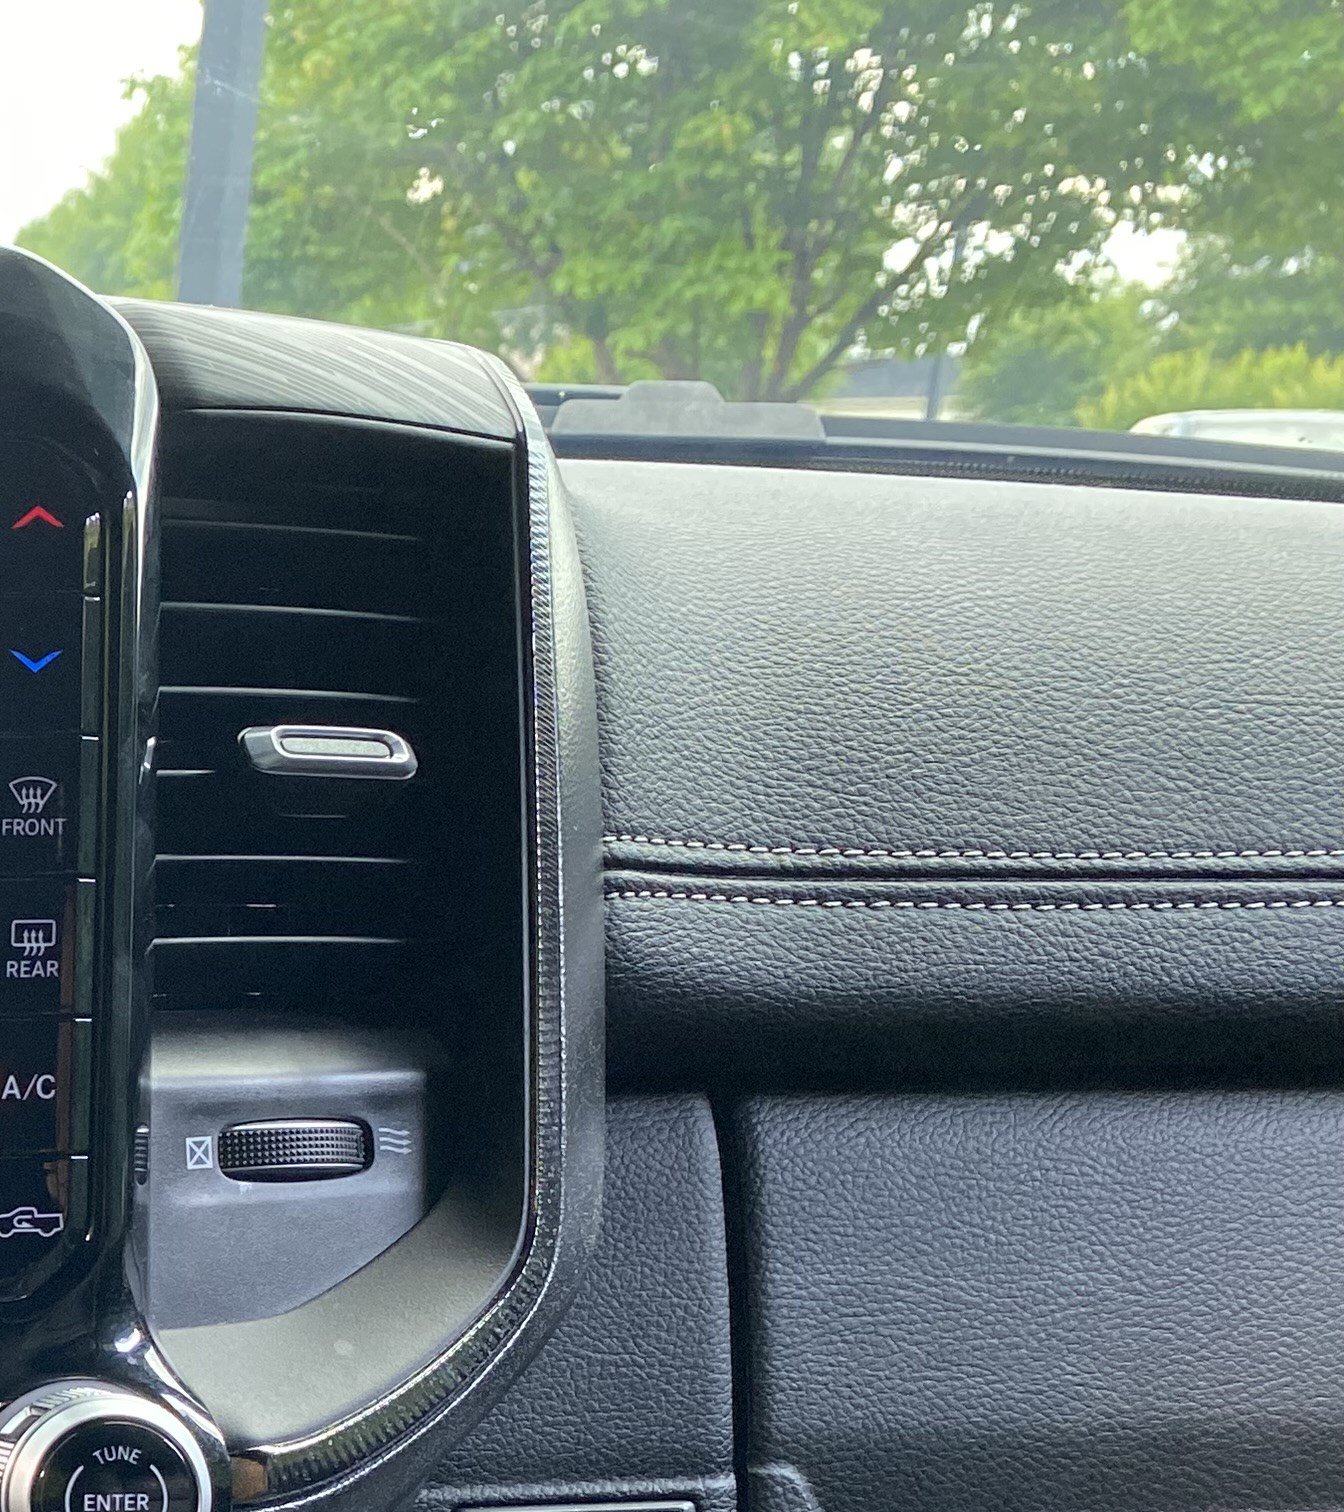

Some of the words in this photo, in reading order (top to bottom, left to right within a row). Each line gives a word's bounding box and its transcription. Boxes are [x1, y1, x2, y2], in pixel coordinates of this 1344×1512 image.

[1, 817, 66, 836] FRONT
[6, 960, 59, 978] REAR
[1, 1074, 56, 1100] A/C
[92, 1445, 142, 1465] TUNE
[83, 1493, 149, 1512] ENTER
